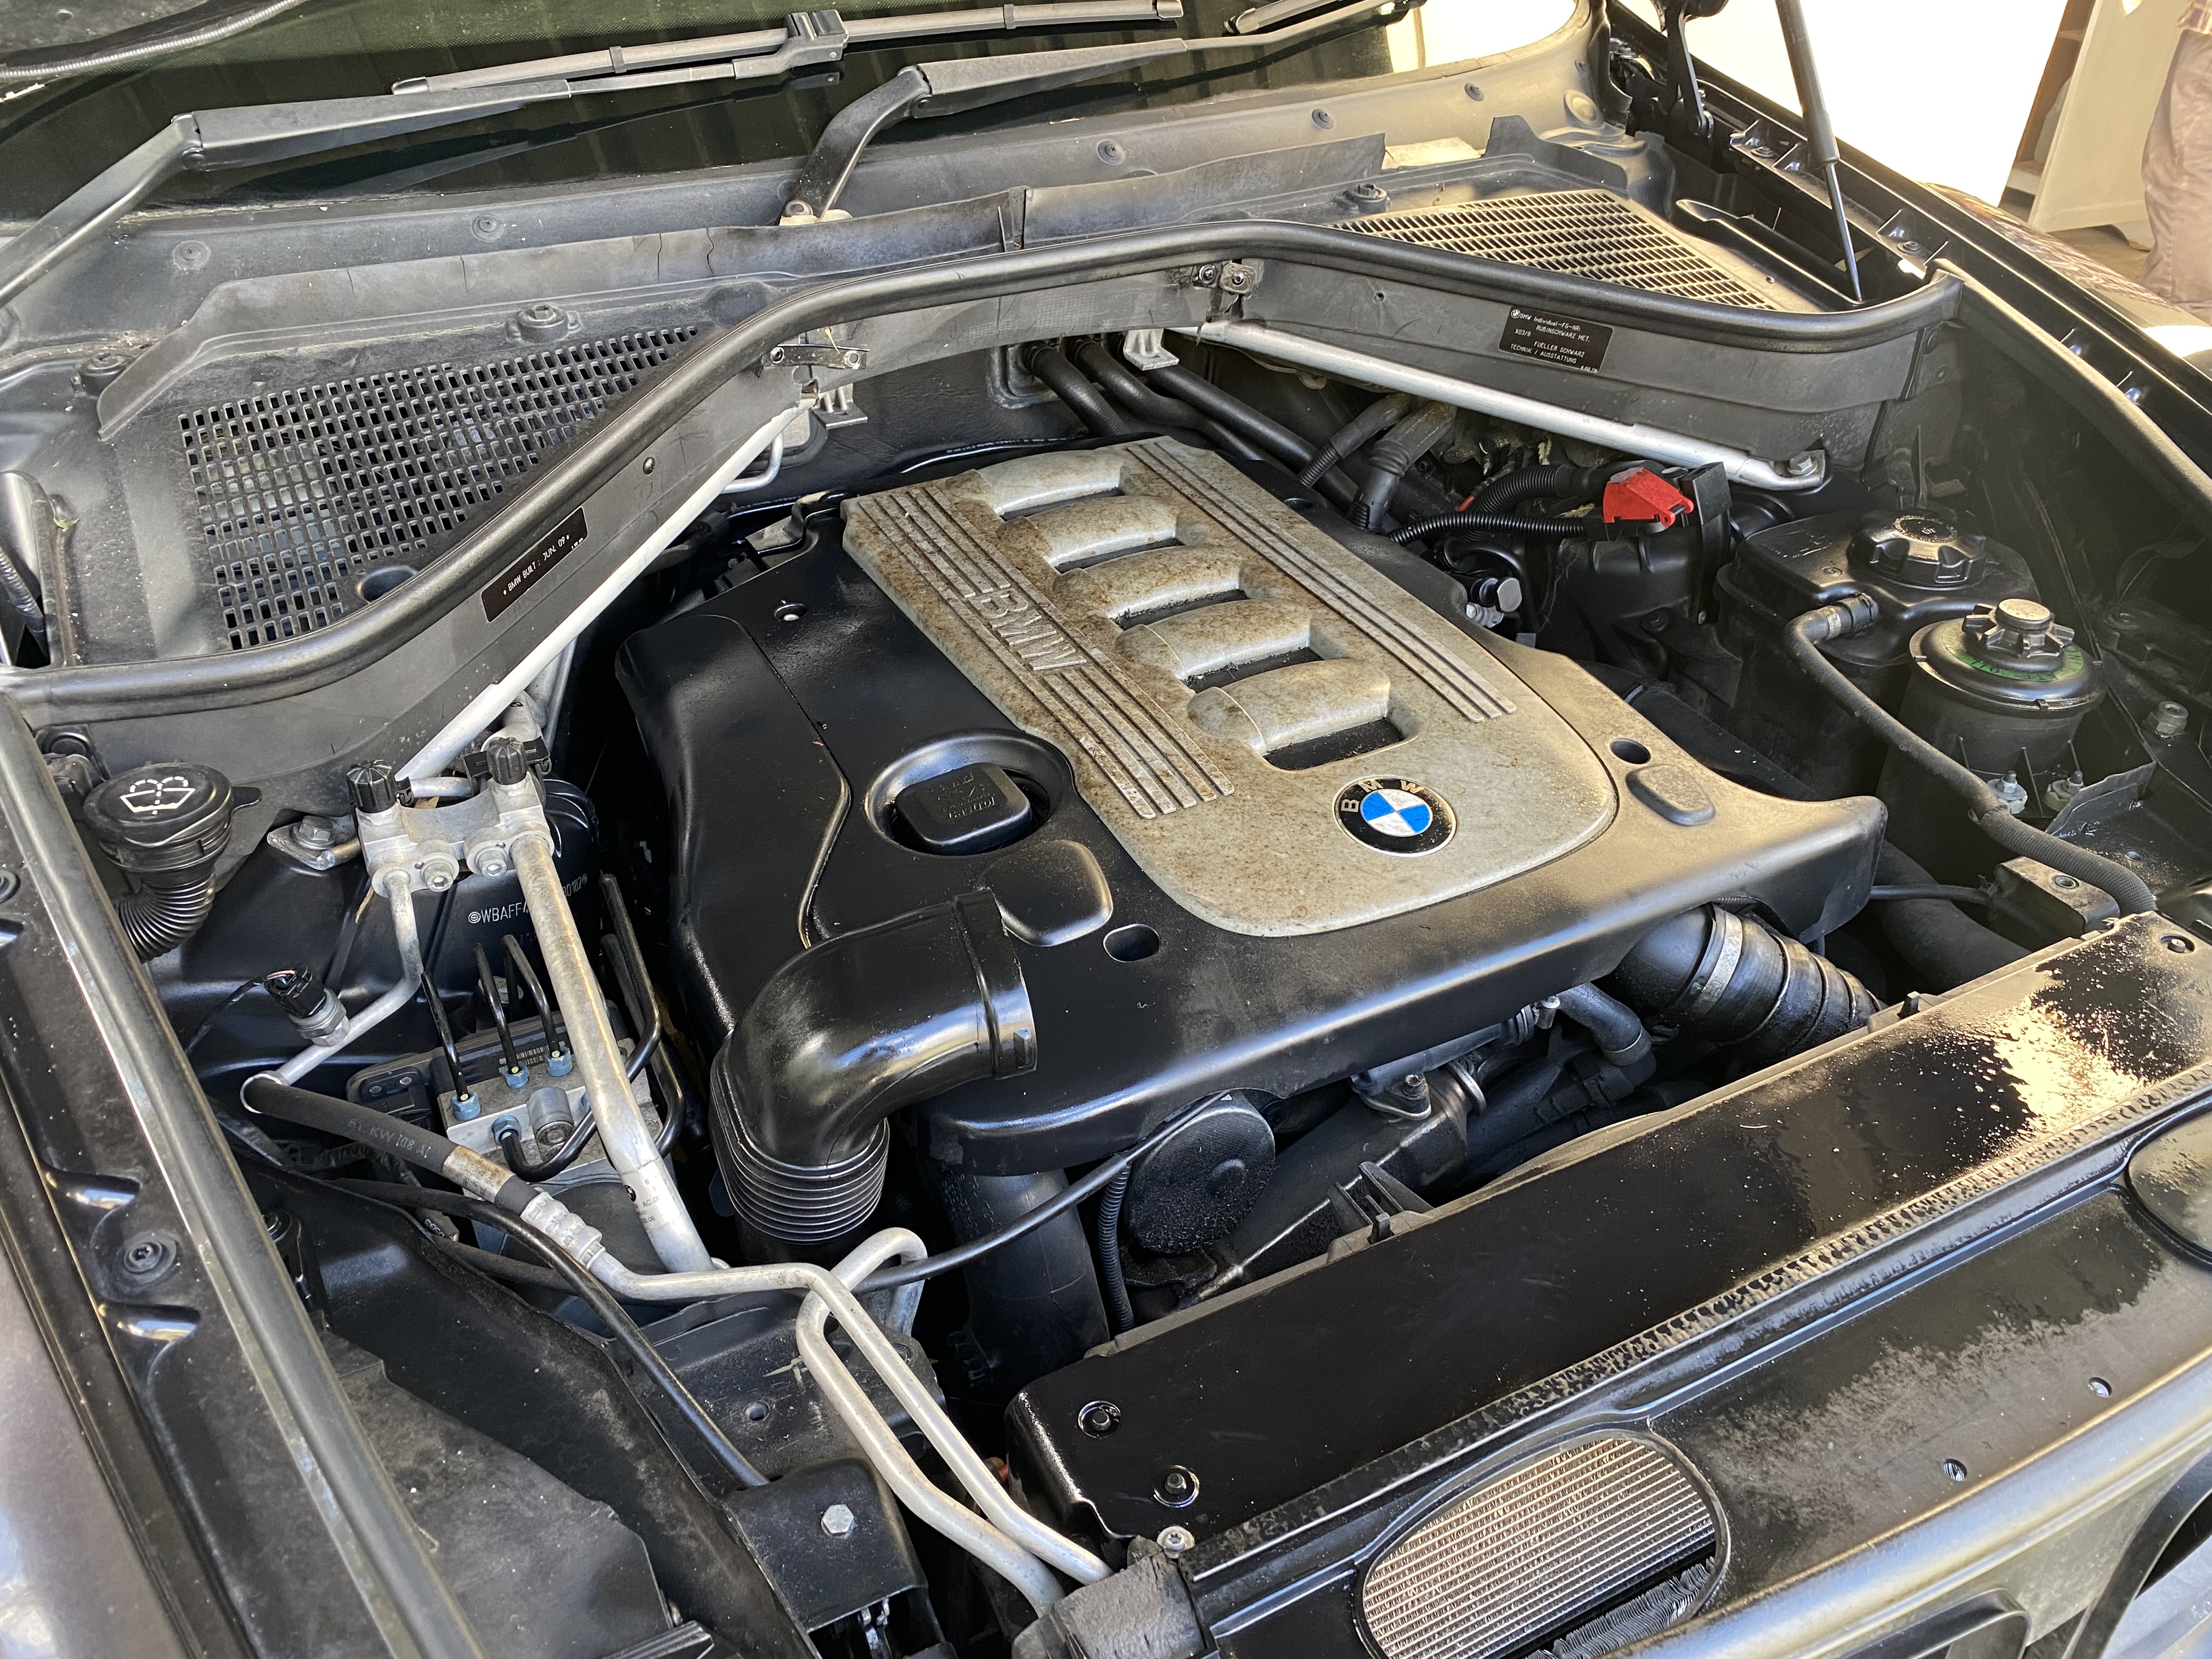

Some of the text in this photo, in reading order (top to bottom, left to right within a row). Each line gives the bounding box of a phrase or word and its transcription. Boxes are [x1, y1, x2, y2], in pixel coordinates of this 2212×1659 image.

[1536, 325, 1576, 339] RUBINSCHWARZ
[1510, 343, 1532, 354] TECHNIK
[1539, 351, 1577, 364] AUSSTATTUNG
[1533, 341, 1585, 357] FUELLER SCHWARZ
[507, 574, 522, 592] BMW
[542, 544, 557, 561] JUN.
[967, 588, 1087, 671] BMW
[1340, 778, 1424, 813] BMW
[370, 1126, 395, 1142] KW
